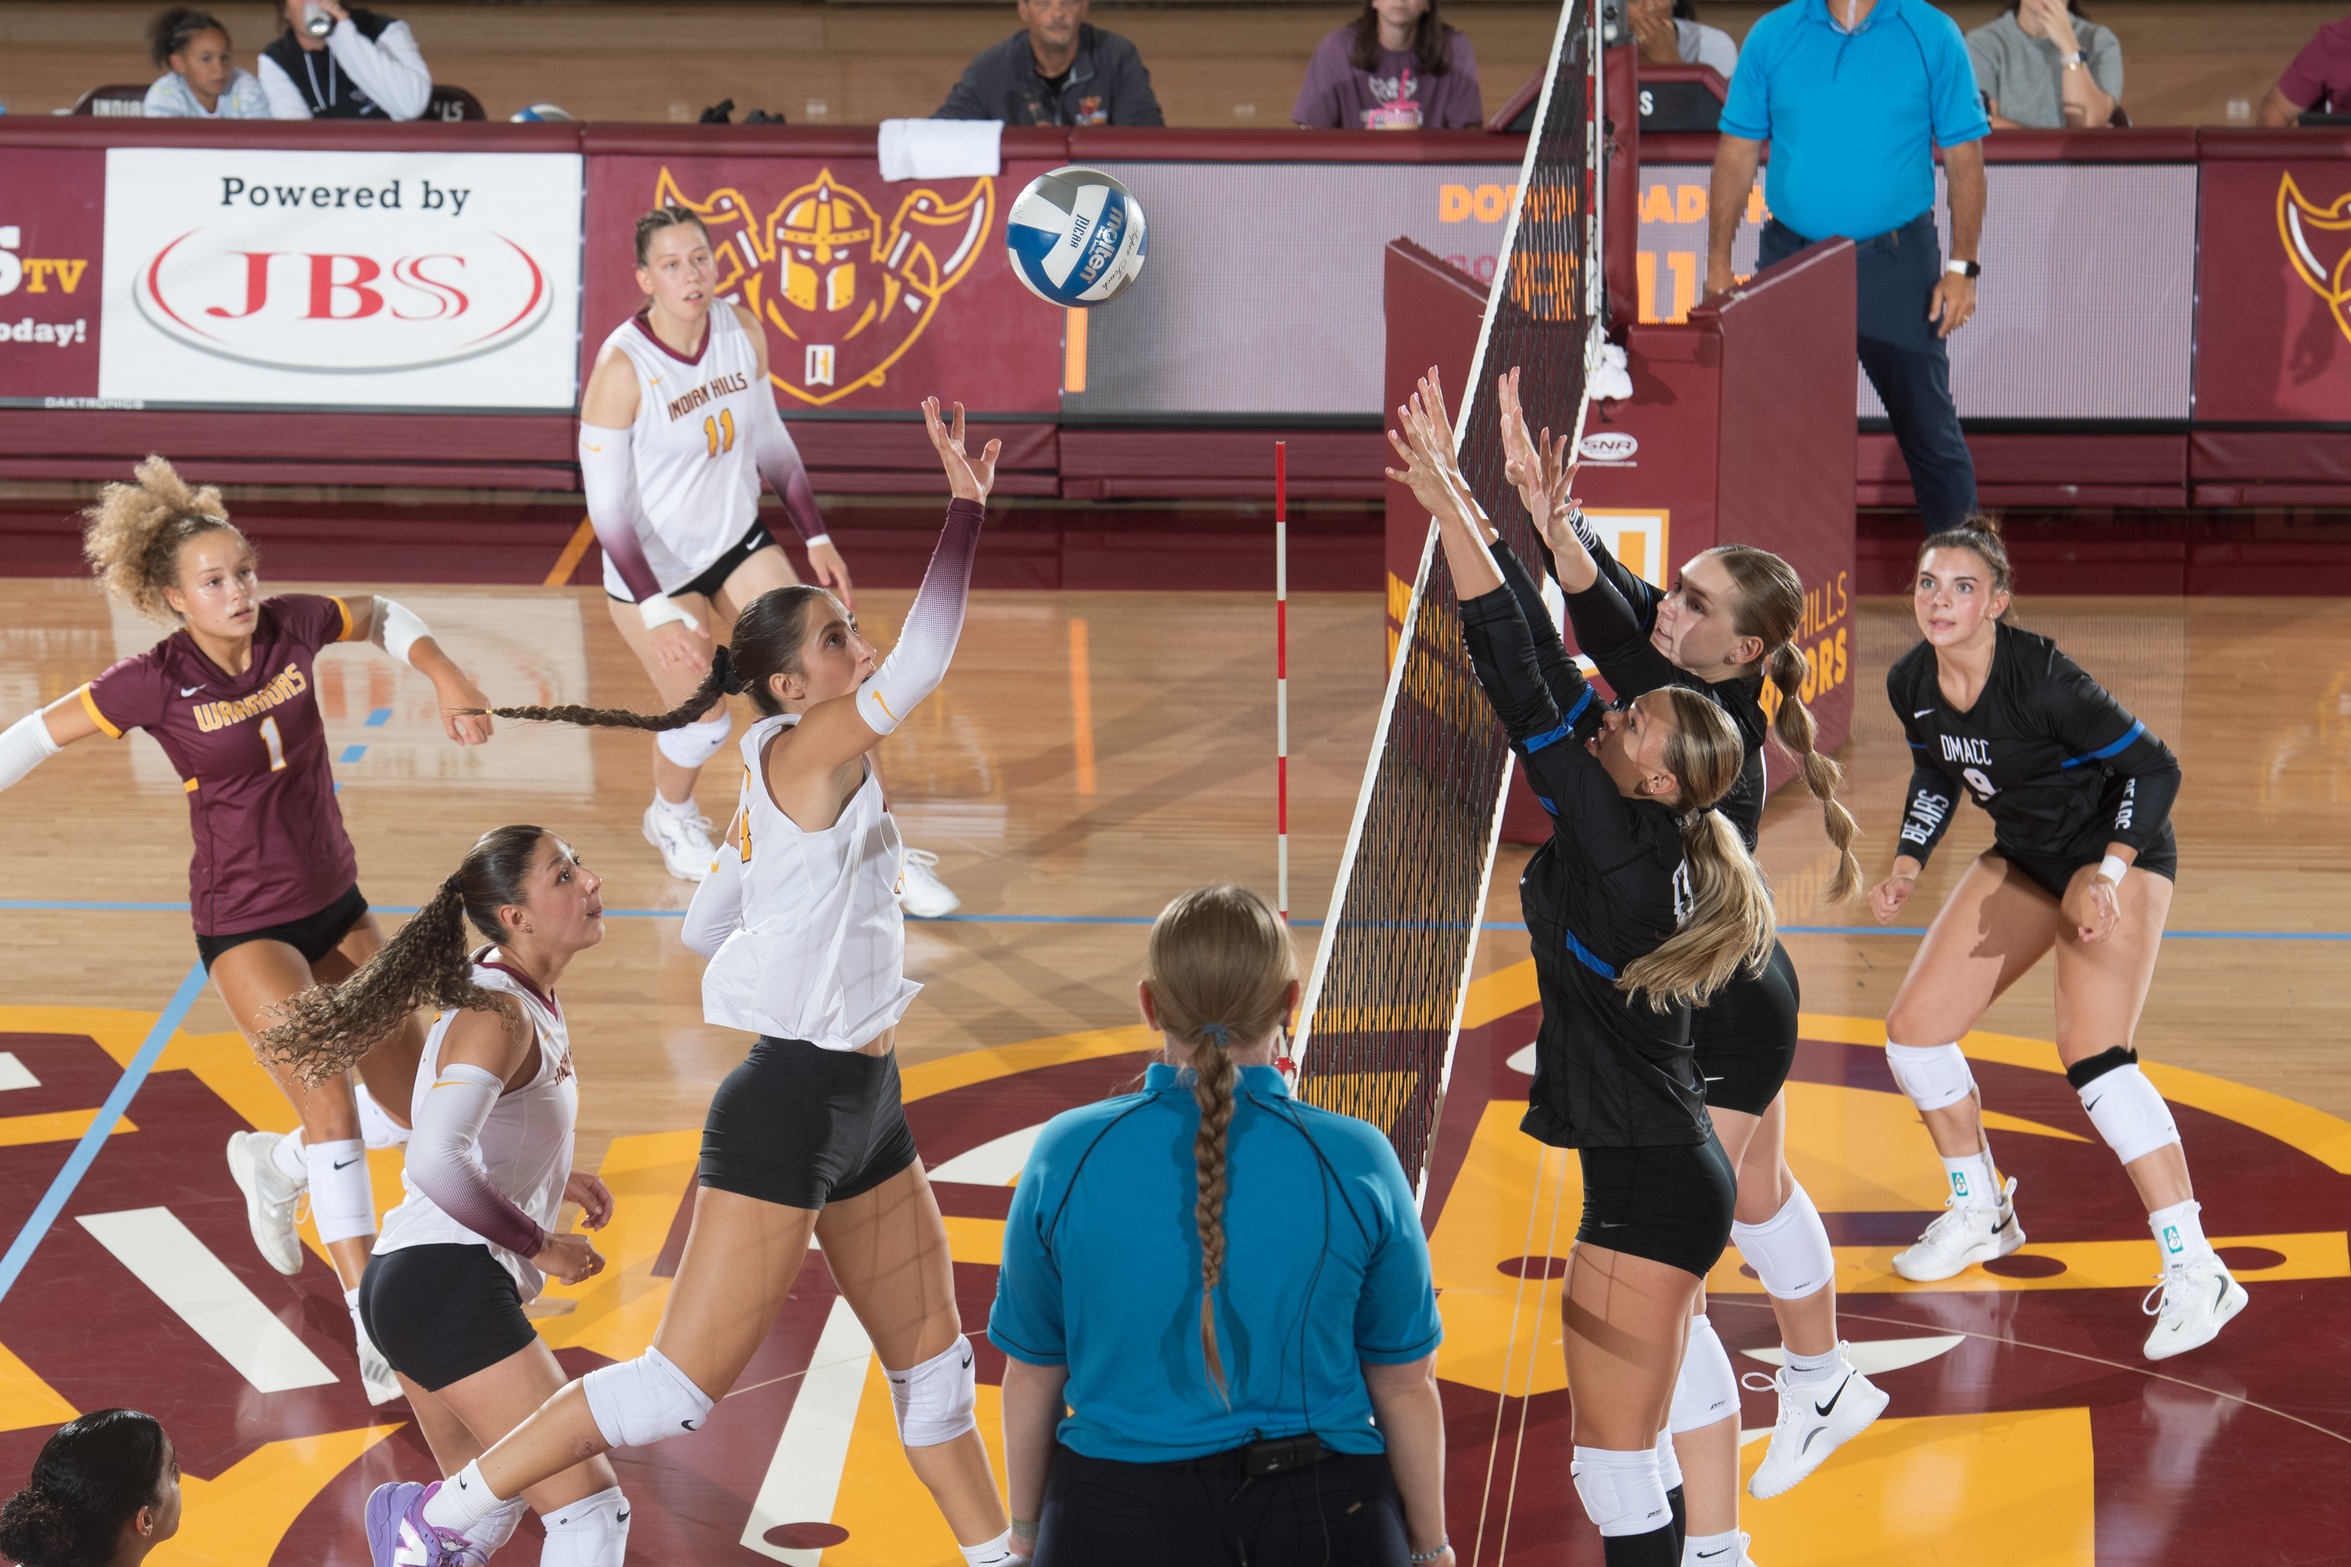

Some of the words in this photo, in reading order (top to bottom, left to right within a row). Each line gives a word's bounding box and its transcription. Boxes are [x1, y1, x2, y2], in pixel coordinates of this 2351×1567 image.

[92, 98, 145, 117] INDIA
[221, 177, 402, 209] Powered
[421, 180, 471, 216] by
[1079, 206, 1124, 284] molten
[204, 252, 470, 319] JBS
[667, 384, 711, 422] INDIAN
[710, 372, 748, 398] HILLS
[703, 407, 735, 458] 11
[192, 662, 307, 733] WARRIORS
[259, 715, 287, 772] 1
[1940, 734, 1993, 766] DMACC
[1901, 788, 1950, 846] BEARS
